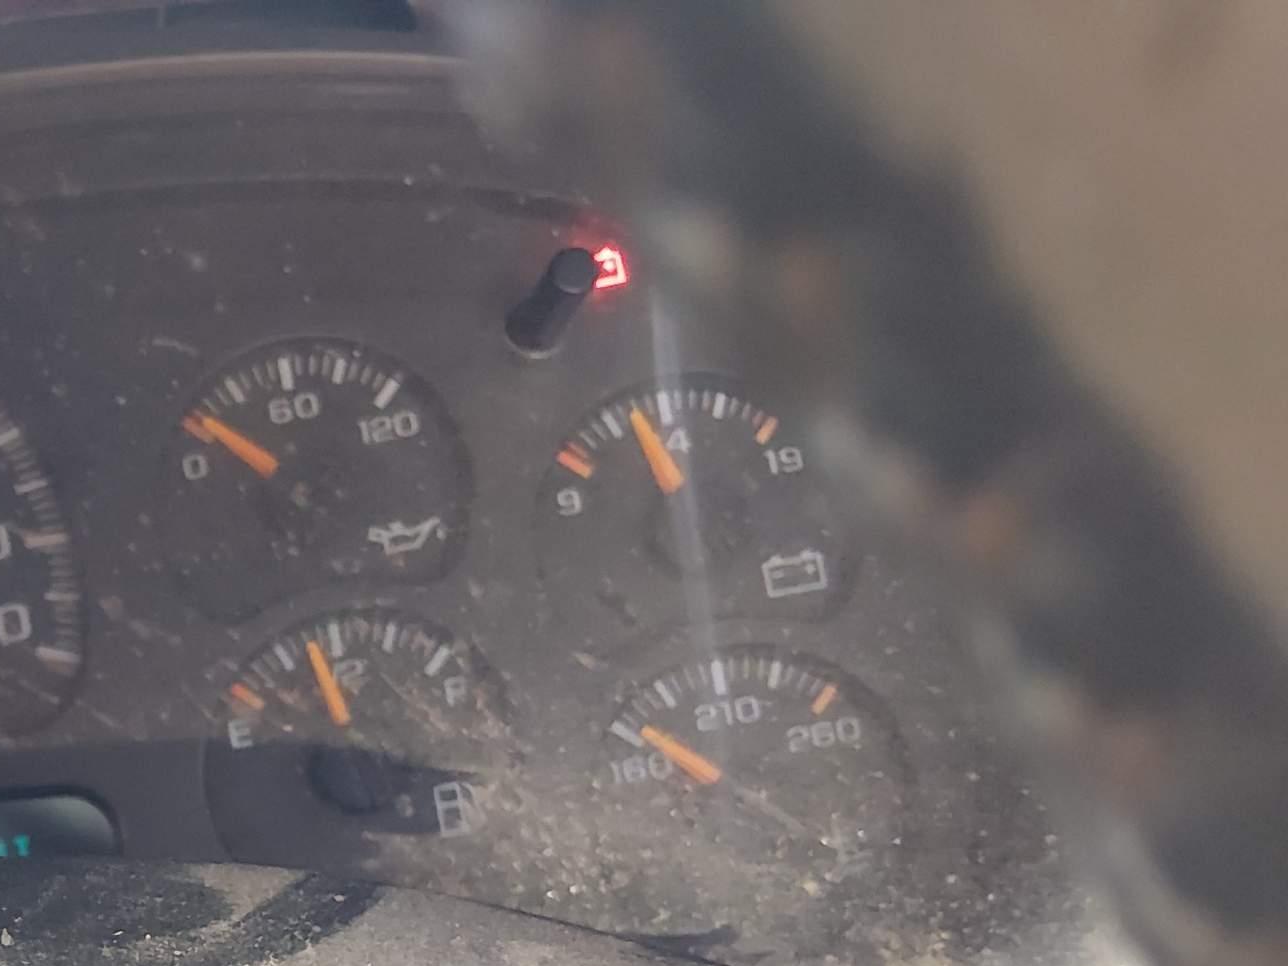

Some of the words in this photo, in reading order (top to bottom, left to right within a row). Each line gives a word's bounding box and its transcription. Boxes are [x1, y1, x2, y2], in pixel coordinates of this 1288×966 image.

[268, 392, 320, 426] 60
[358, 410, 420, 446] 120
[181, 454, 209, 482] 0
[764, 446, 804, 475] 19
[556, 489, 582, 516] 9
[694, 696, 761, 731] 210
[228, 719, 253, 749] E
[787, 717, 862, 753] 260
